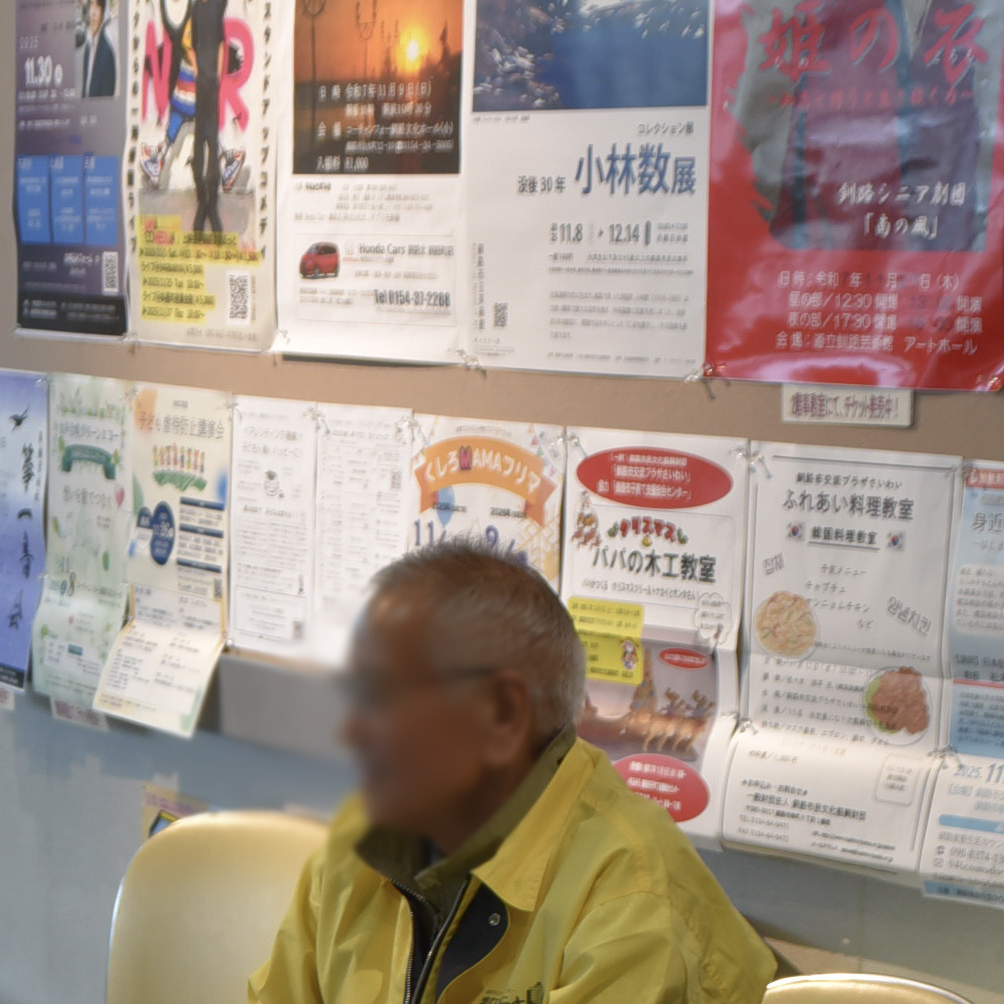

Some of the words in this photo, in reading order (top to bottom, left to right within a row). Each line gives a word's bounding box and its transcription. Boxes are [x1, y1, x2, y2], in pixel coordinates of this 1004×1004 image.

[637, 121, 694, 135] コレクション展
[574, 142, 697, 196] 小林数展
[560, 222, 584, 243] 11.8
[608, 222, 640, 243] 12.14
[426, 445, 542, 493] くしろMAMAフリマ
[781, 488, 915, 521] ふれあい料理教室
[619, 515, 677, 544] クリスマス
[811, 525, 879, 546] 韓国料理教室
[592, 545, 717, 584] パパの木工教室
